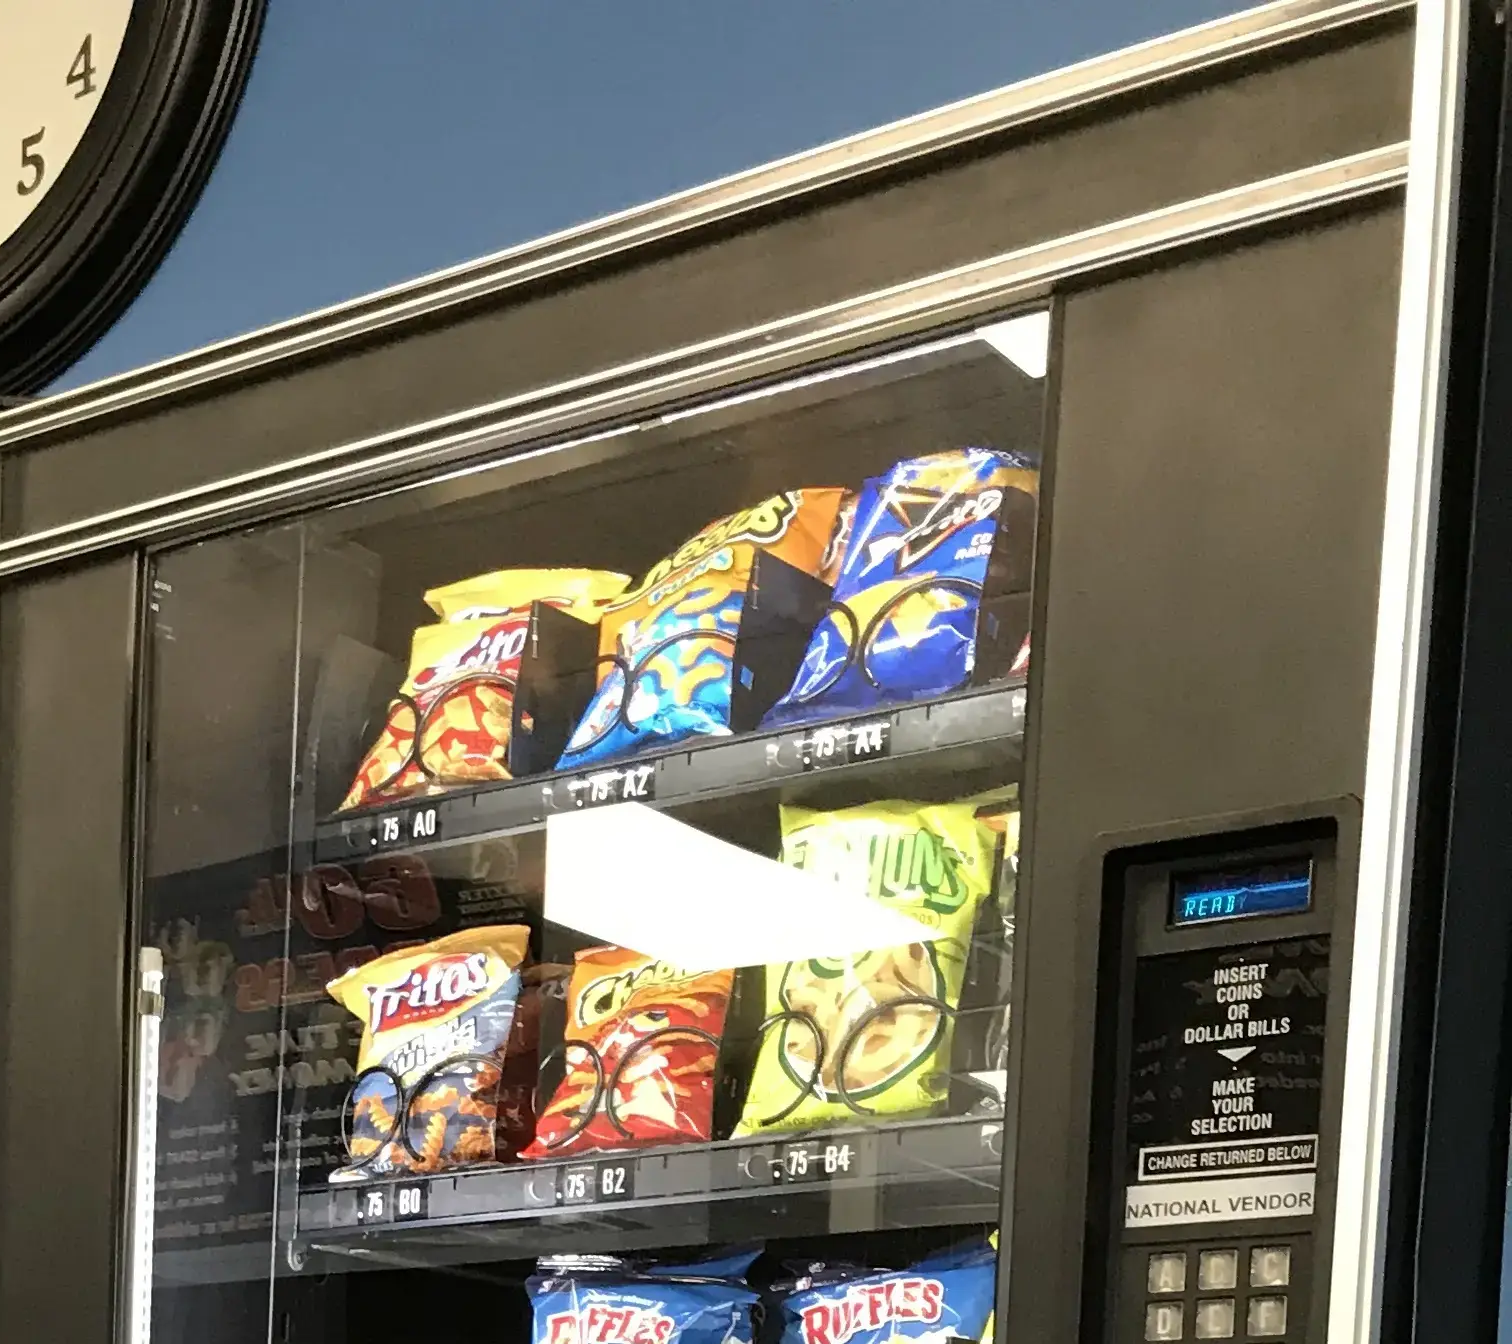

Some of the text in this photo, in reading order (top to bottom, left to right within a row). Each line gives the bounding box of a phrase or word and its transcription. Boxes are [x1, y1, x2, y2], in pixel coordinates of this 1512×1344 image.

[66, 34, 97, 99] 4
[17, 127, 46, 196] 5
[854, 727, 883, 756] A4
[622, 772, 649, 799] A2
[370, 817, 399, 846] .75
[1213, 963, 1269, 985] INSERT
[364, 952, 490, 1034] Fritos
[1216, 982, 1263, 1003] COINS
[1227, 1003, 1250, 1022] OR
[1184, 1016, 1291, 1045] DOLLAR BILLS
[1211, 1077, 1256, 1097] MAKE
[1211, 1096, 1254, 1115] YOUR
[1190, 1112, 1273, 1137] SELECTION
[825, 1146, 850, 1172] B4
[1147, 1144, 1312, 1171] CHANGE RETURNED BELOW
[602, 1167, 625, 1195] B2
[357, 1192, 383, 1219] .75
[1126, 1191, 1312, 1220] NATIONAL VENDOR
[1159, 1258, 1172, 1287] A
[1157, 1307, 1171, 1337] D
[1260, 1301, 1275, 1331] F
